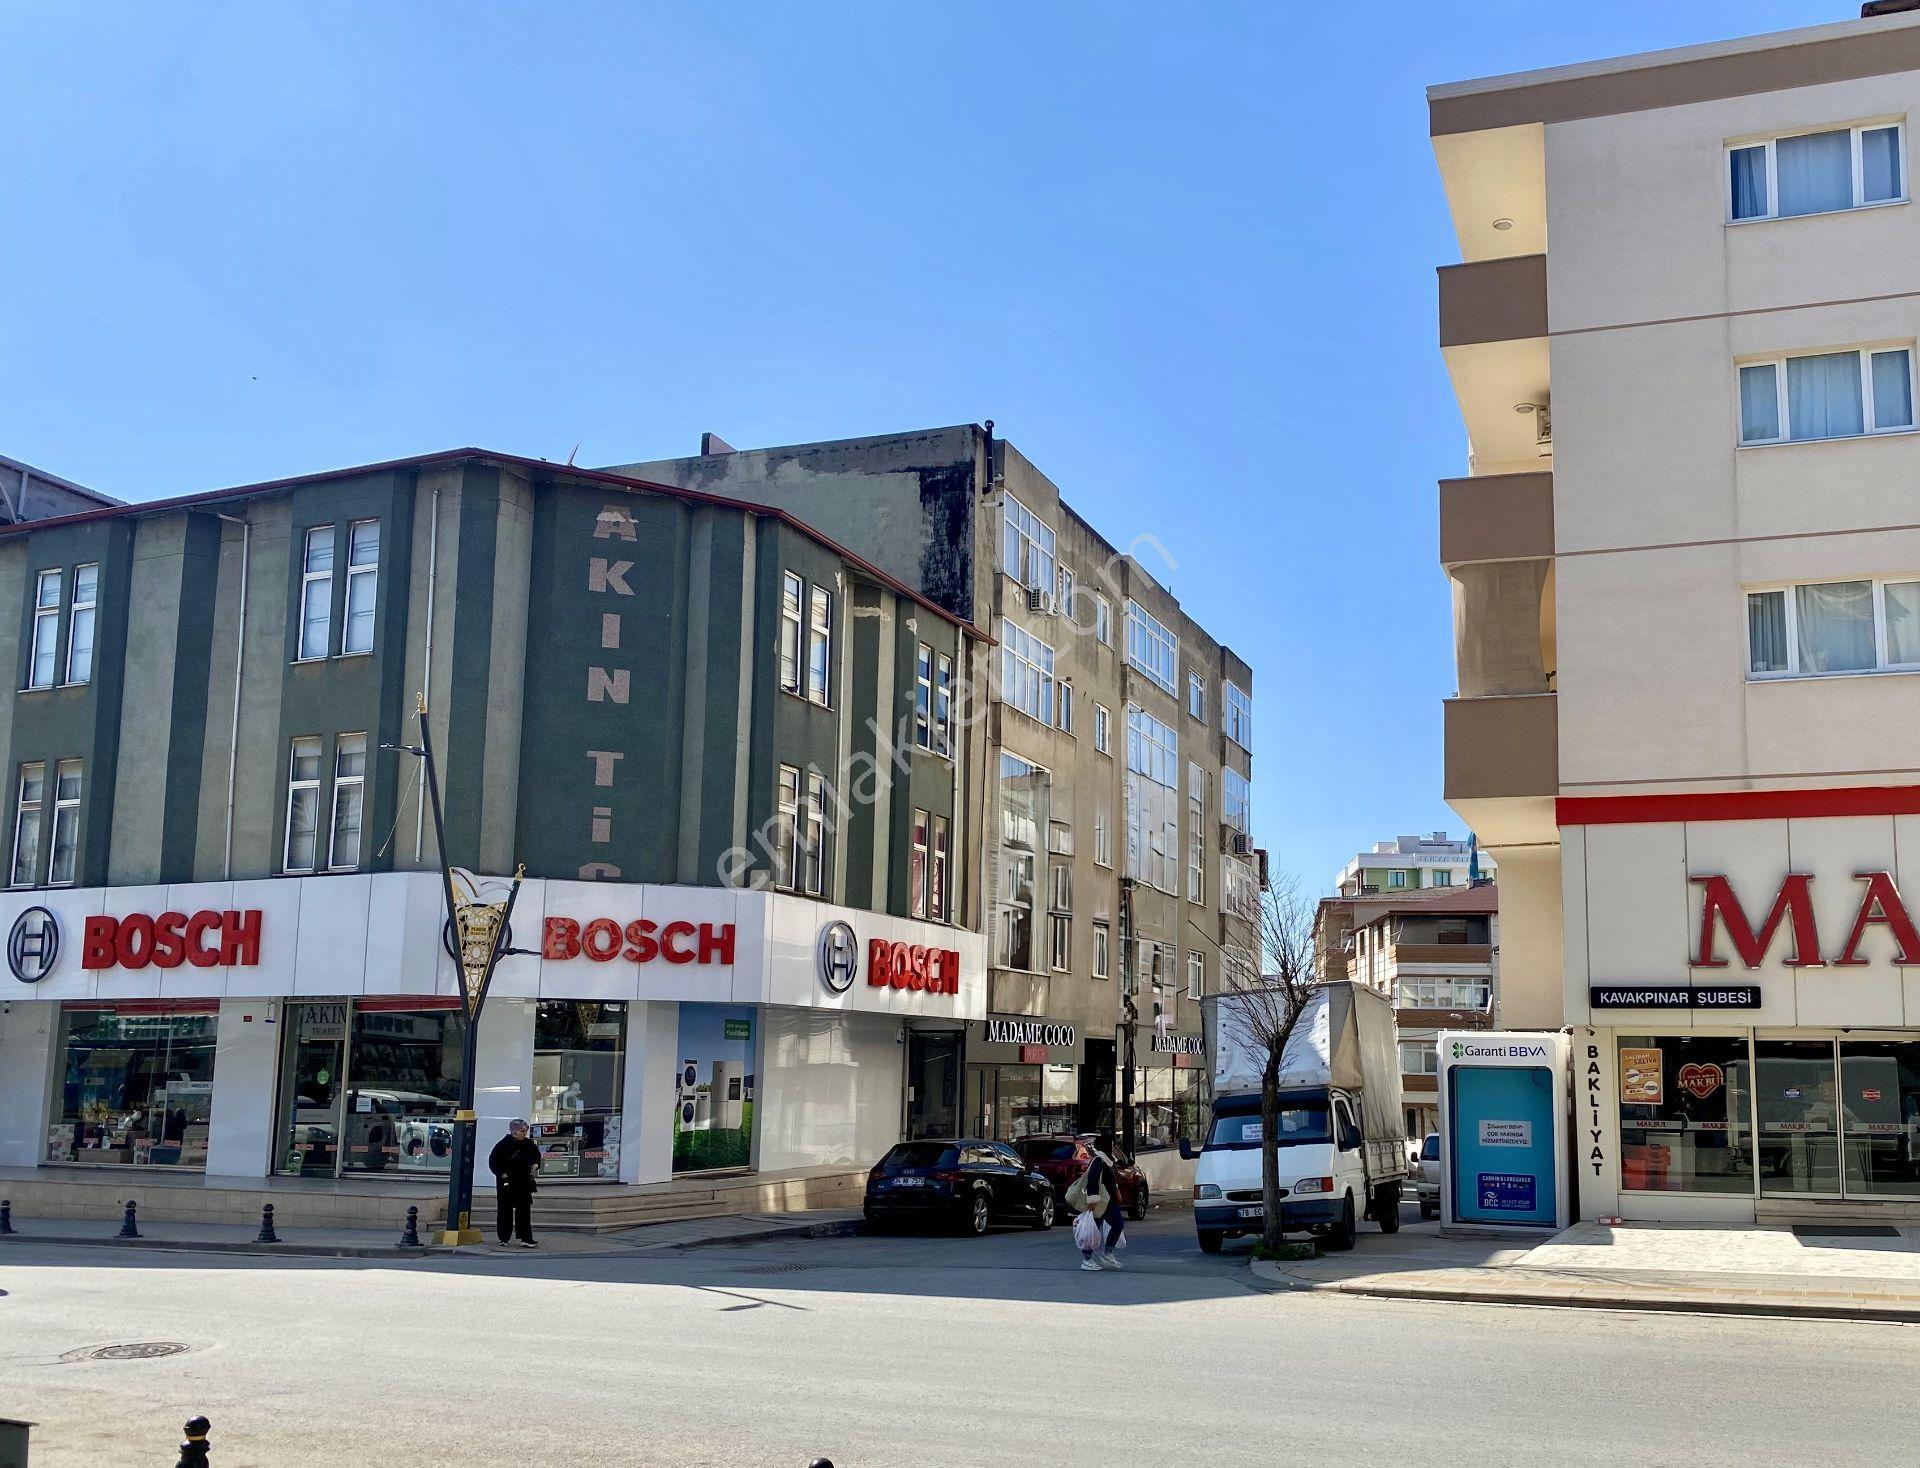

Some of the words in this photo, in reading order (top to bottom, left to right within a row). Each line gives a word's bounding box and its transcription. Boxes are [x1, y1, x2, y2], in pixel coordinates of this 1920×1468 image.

[587, 504, 639, 705] AKIN
[82, 909, 263, 970] BOSCH
[542, 916, 736, 966] BOSCH
[868, 938, 960, 995] BOSCH
[1600, 991, 1689, 1004] KAVAKPINAR
[1697, 988, 1752, 1006] ŞUBESİ
[305, 1005, 346, 1024] AKIN
[988, 1020, 1042, 1045] MADAME
[1045, 1023, 1075, 1047] COCO
[1154, 1035, 1187, 1054] MADAME
[1187, 1037, 1204, 1055] COC
[1465, 1045, 1507, 1057] Garanti
[1509, 1046, 1546, 1057] BBVA
[1677, 1077, 1725, 1089] MAKBUL
[1587, 1045, 1603, 1176] BAKLİYAT
[1868, 1123, 1901, 1131] MAKBUL
[1484, 1199, 1499, 1207] DCC
